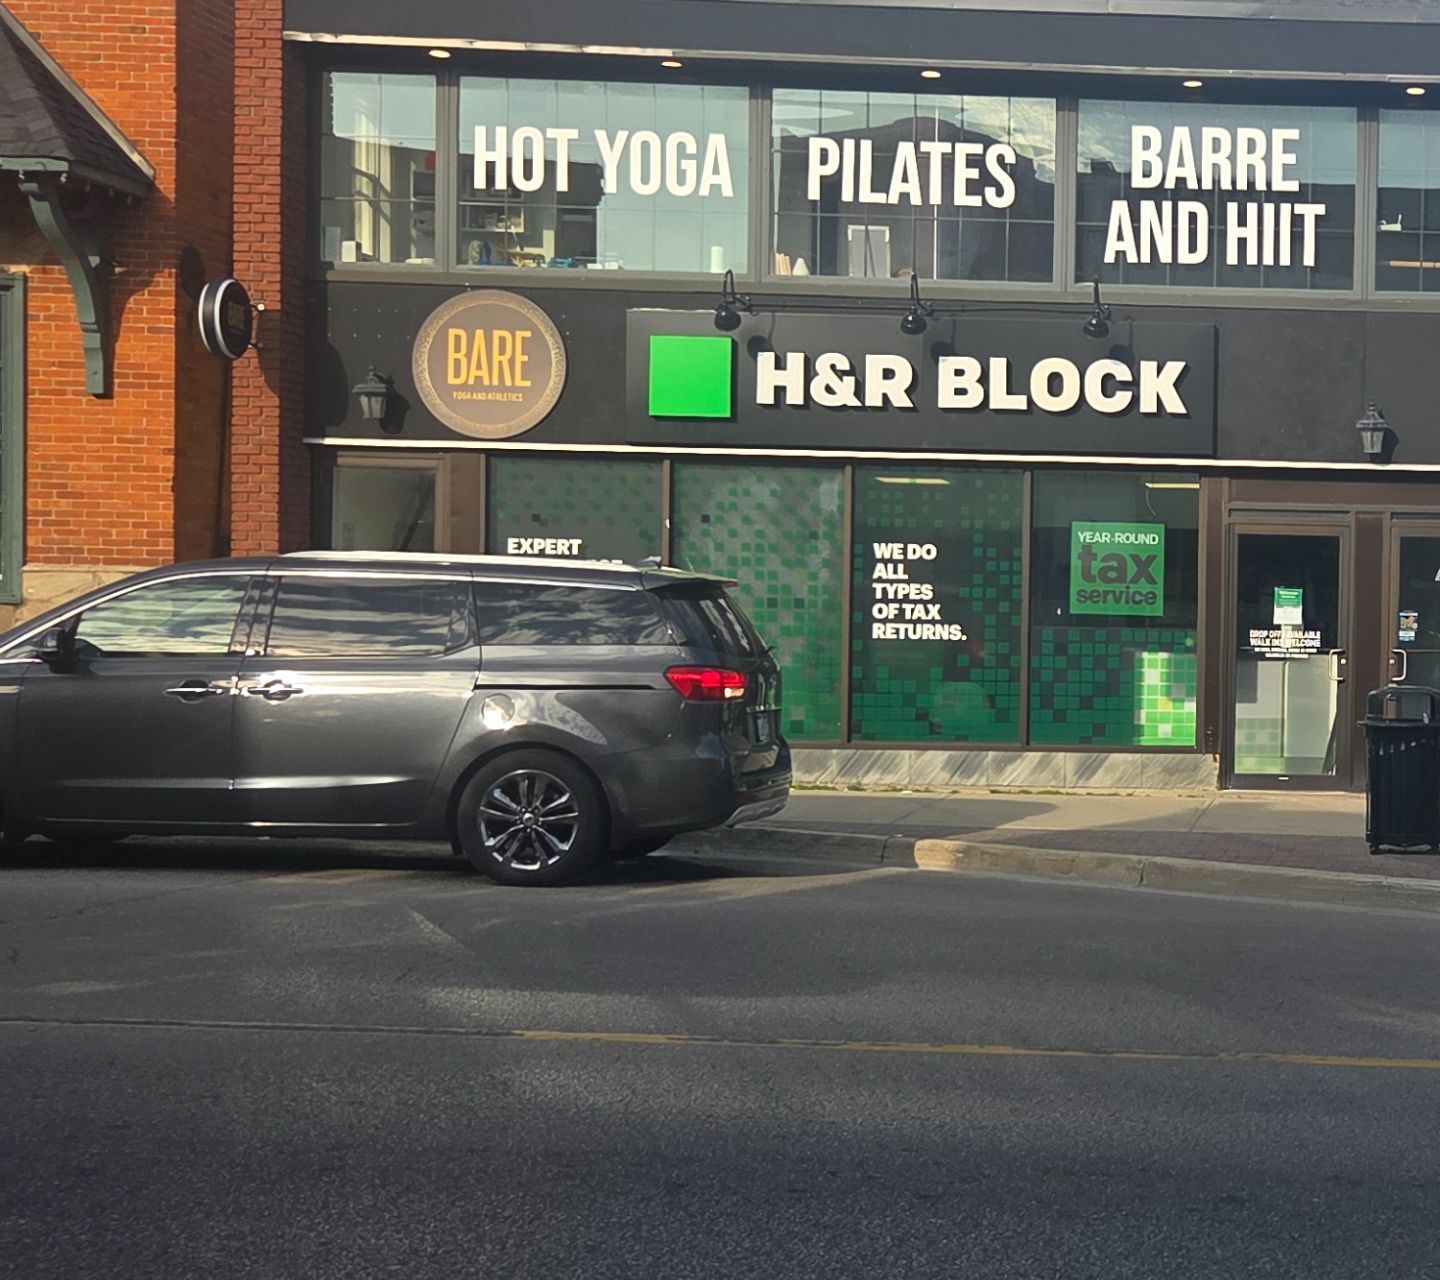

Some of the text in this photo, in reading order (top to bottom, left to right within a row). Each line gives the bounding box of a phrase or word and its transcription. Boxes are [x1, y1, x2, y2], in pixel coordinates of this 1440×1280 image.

[473, 125, 734, 198] HOT YOGA
[1130, 125, 1301, 192] BARRE
[807, 137, 1017, 209] PILATES
[1103, 199, 1326, 267] AND HIIT
[447, 328, 532, 387] BARE
[756, 351, 1189, 415] H&R BLOCK
[507, 537, 582, 556] EXPERT
[1077, 530, 1160, 545] YEAR-ROUND
[872, 542, 938, 561] WE DO
[872, 562, 909, 580] ALL
[1077, 544, 1159, 586] tax
[872, 582, 934, 601] TYPES
[1076, 585, 1158, 606] service
[871, 602, 942, 621] OF TAX
[871, 622, 968, 641] RETURNS.
